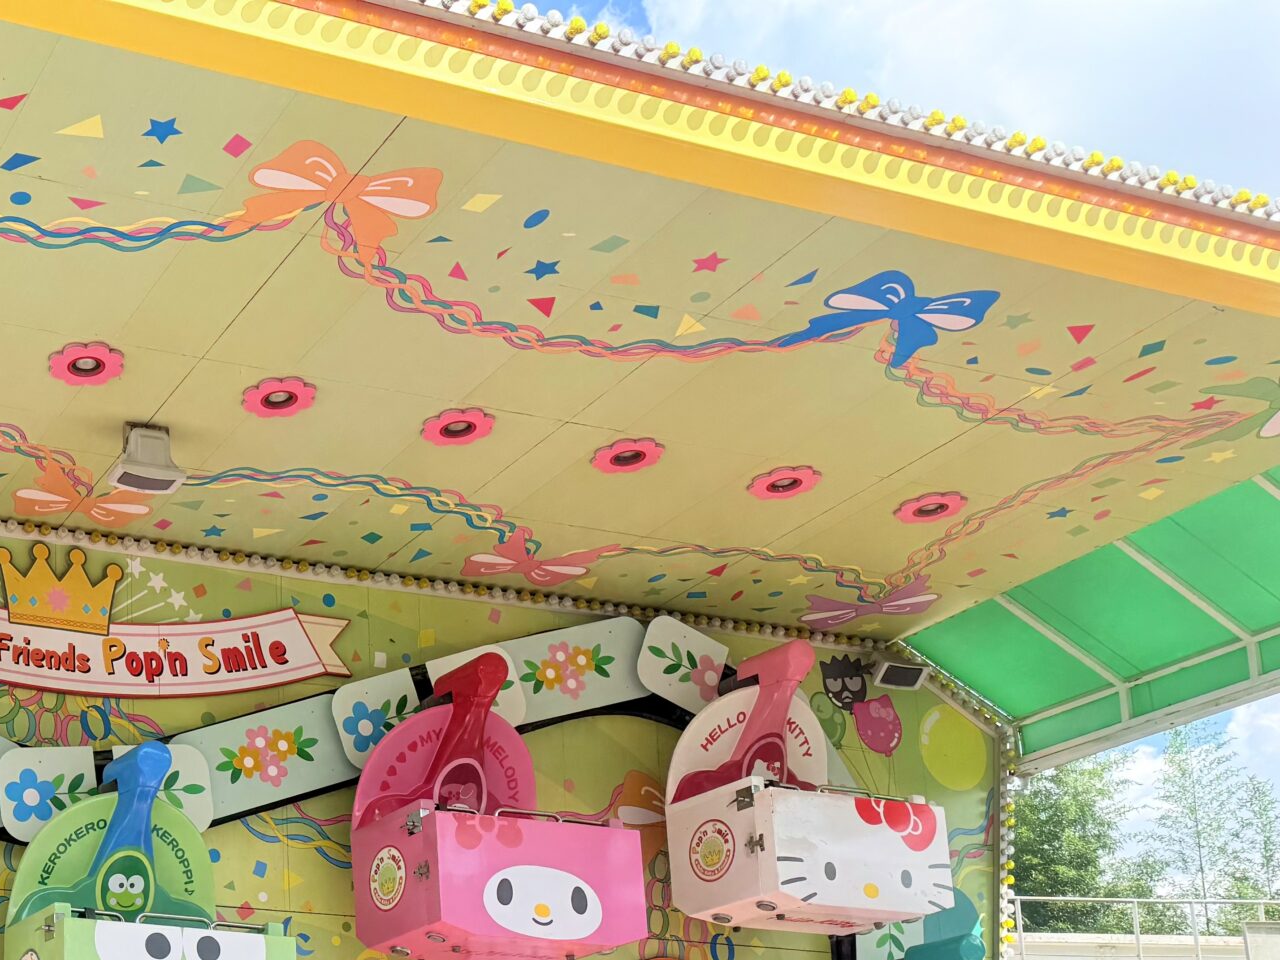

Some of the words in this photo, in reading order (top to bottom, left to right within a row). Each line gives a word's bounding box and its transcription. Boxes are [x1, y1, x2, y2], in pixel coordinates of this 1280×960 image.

[197, 631, 289, 675] Smile
[700, 711, 747, 752] HELLO
[786, 717, 812, 757] KITTY
[419, 727, 443, 747] MY
[483, 736, 520, 803] MELODY
[38, 818, 108, 886] KEROKERO
